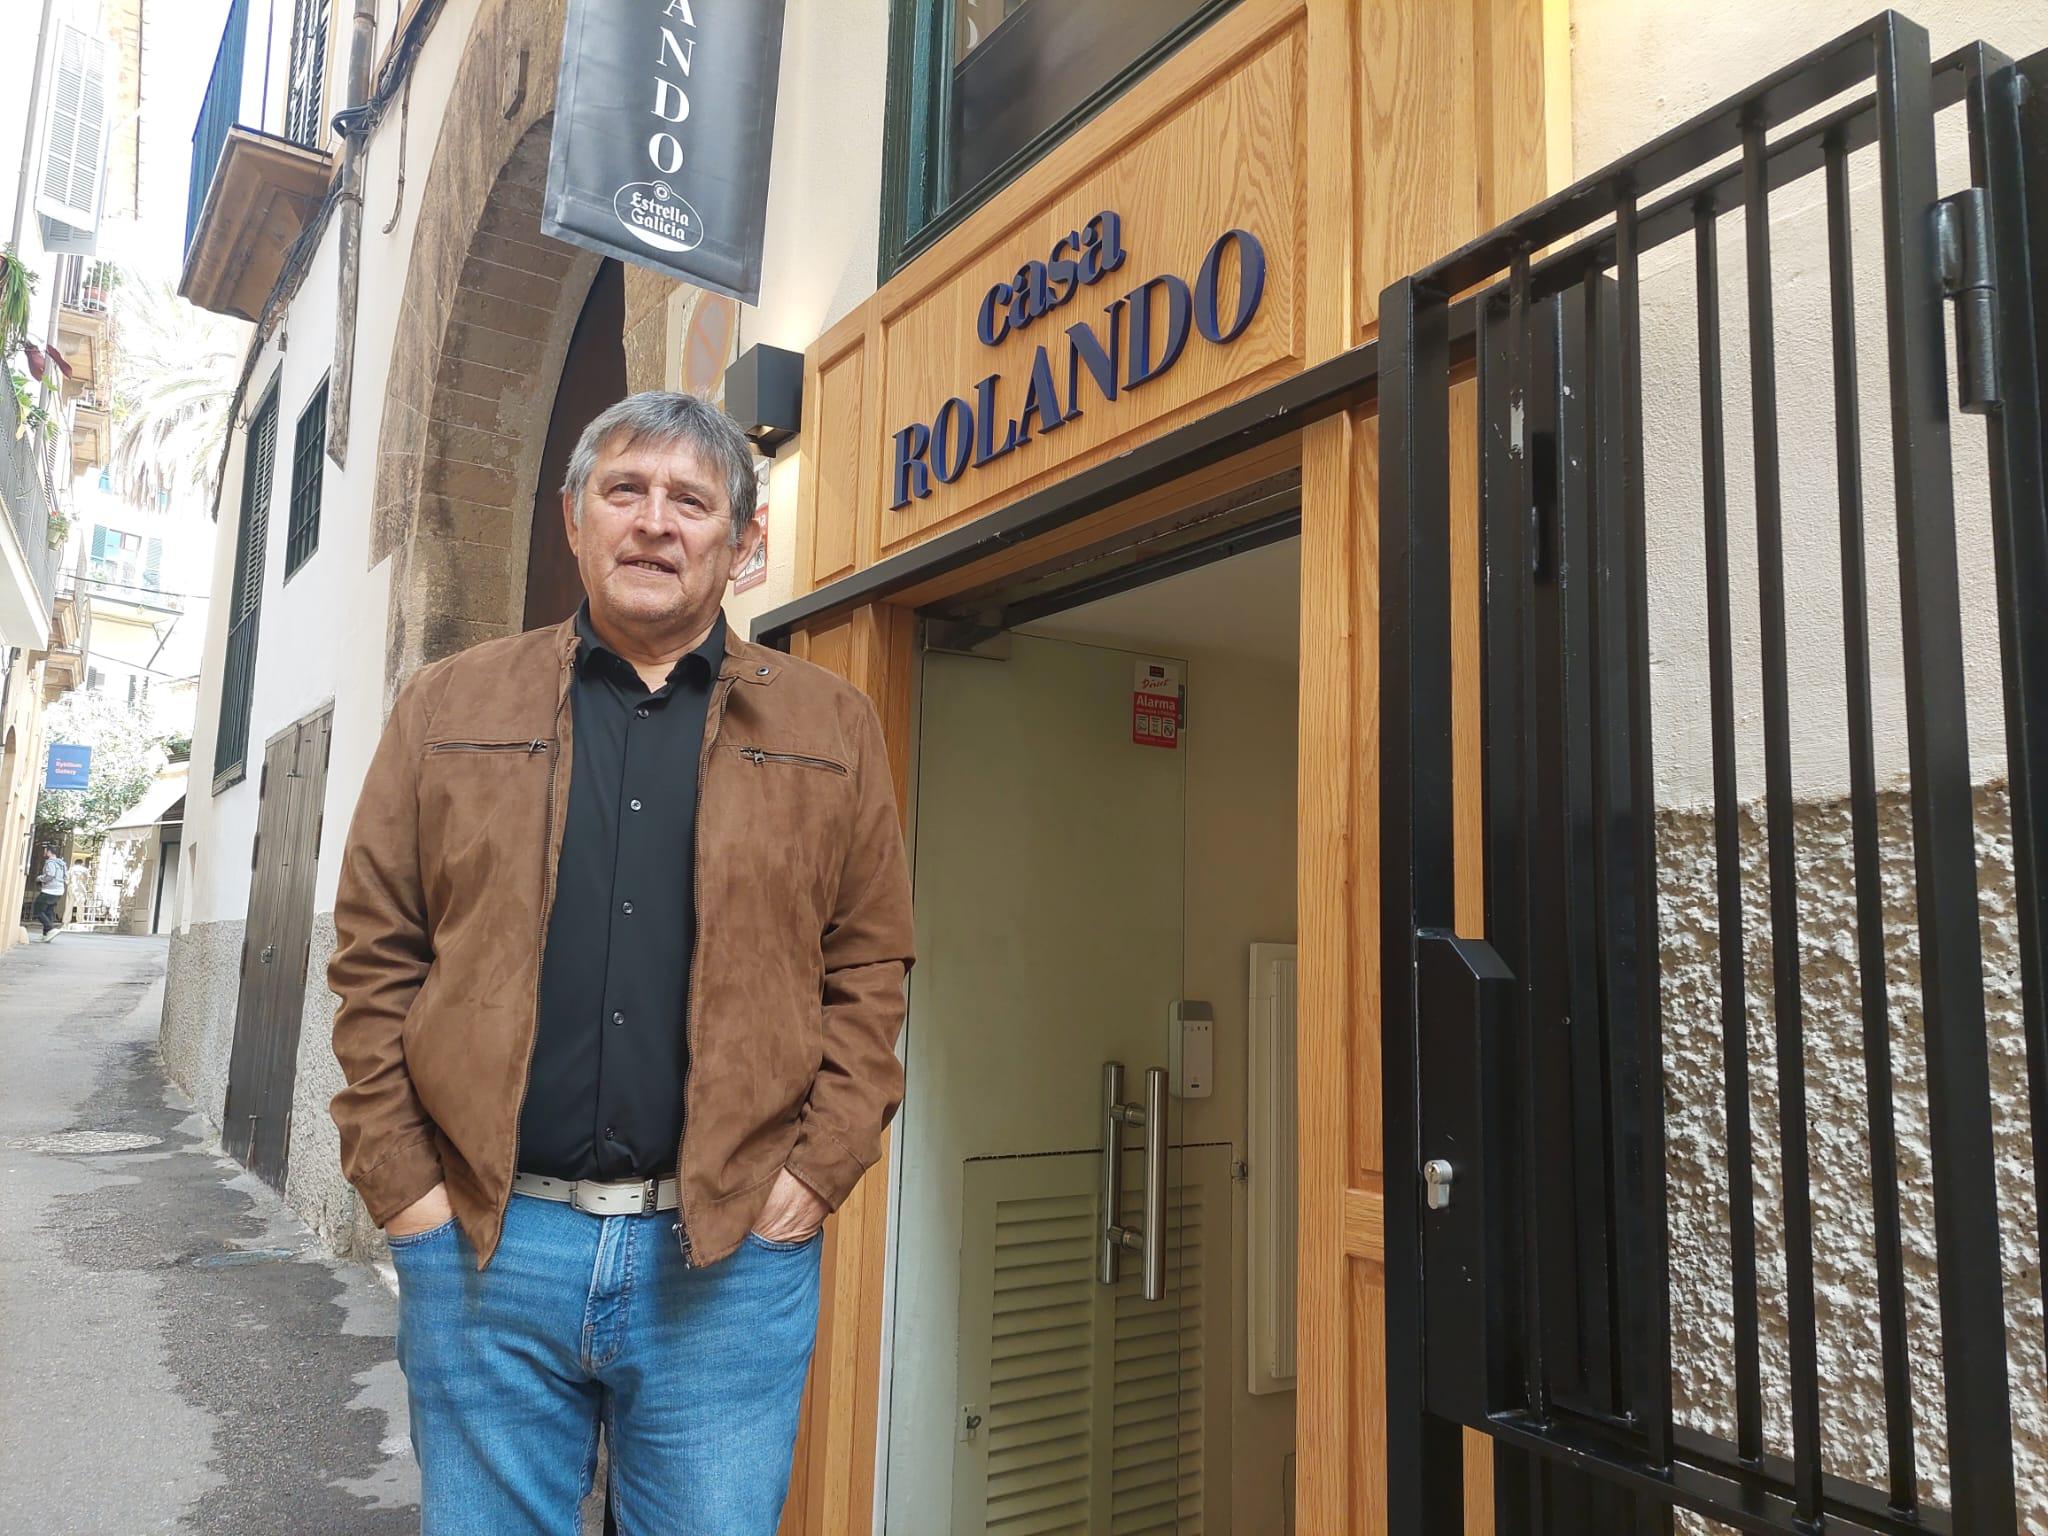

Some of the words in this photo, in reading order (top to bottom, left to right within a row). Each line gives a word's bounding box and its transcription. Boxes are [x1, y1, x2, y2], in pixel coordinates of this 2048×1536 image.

[630, 192, 689, 227] Estrella
[631, 208, 685, 240] Galicia
[977, 210, 1127, 347] casa
[889, 228, 1267, 512] ROLANDO
[1136, 694, 1176, 711] Alarma
